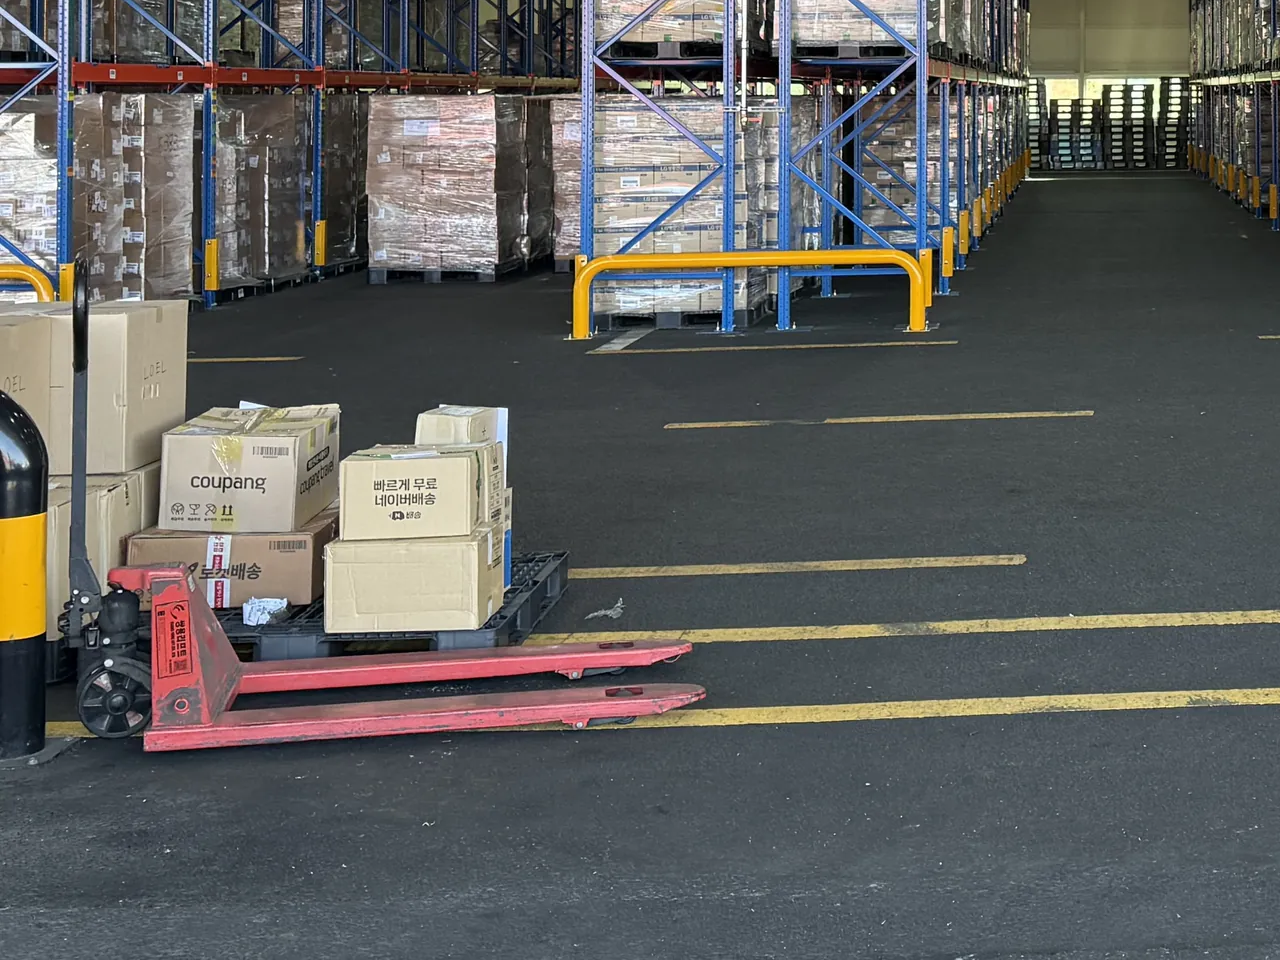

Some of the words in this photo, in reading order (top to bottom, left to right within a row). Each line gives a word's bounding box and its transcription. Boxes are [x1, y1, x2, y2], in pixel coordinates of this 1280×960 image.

[191, 476, 267, 494] coupang
[373, 478, 410, 492] 빠르게
[413, 478, 438, 491] 무료
[374, 492, 437, 507] 네이버배송
[175, 620, 187, 657] 쌍용리프트
